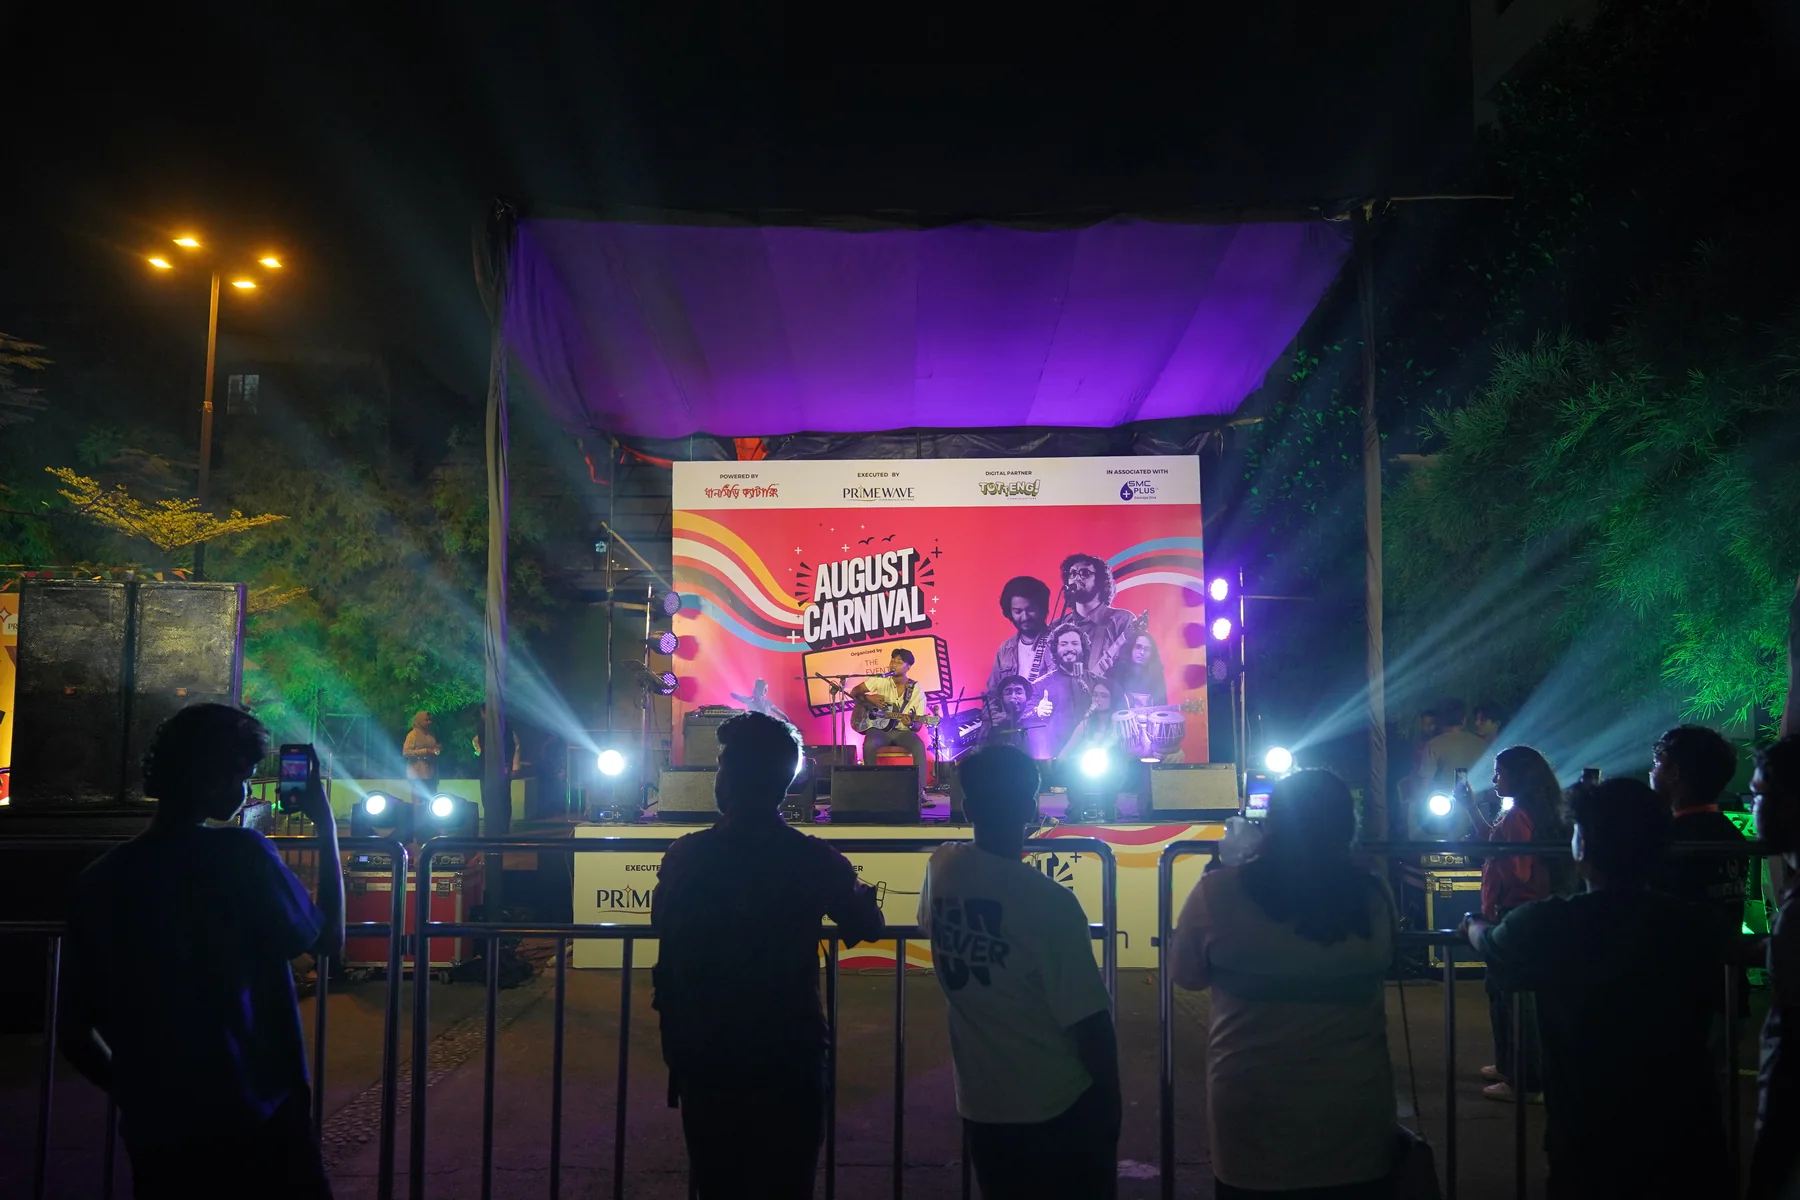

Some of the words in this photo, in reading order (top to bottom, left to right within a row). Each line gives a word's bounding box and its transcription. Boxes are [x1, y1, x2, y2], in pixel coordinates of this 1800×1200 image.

[814, 548, 916, 603] AUGUST
[803, 586, 928, 646] CARNIVAL
[851, 649, 876, 657] Organized
